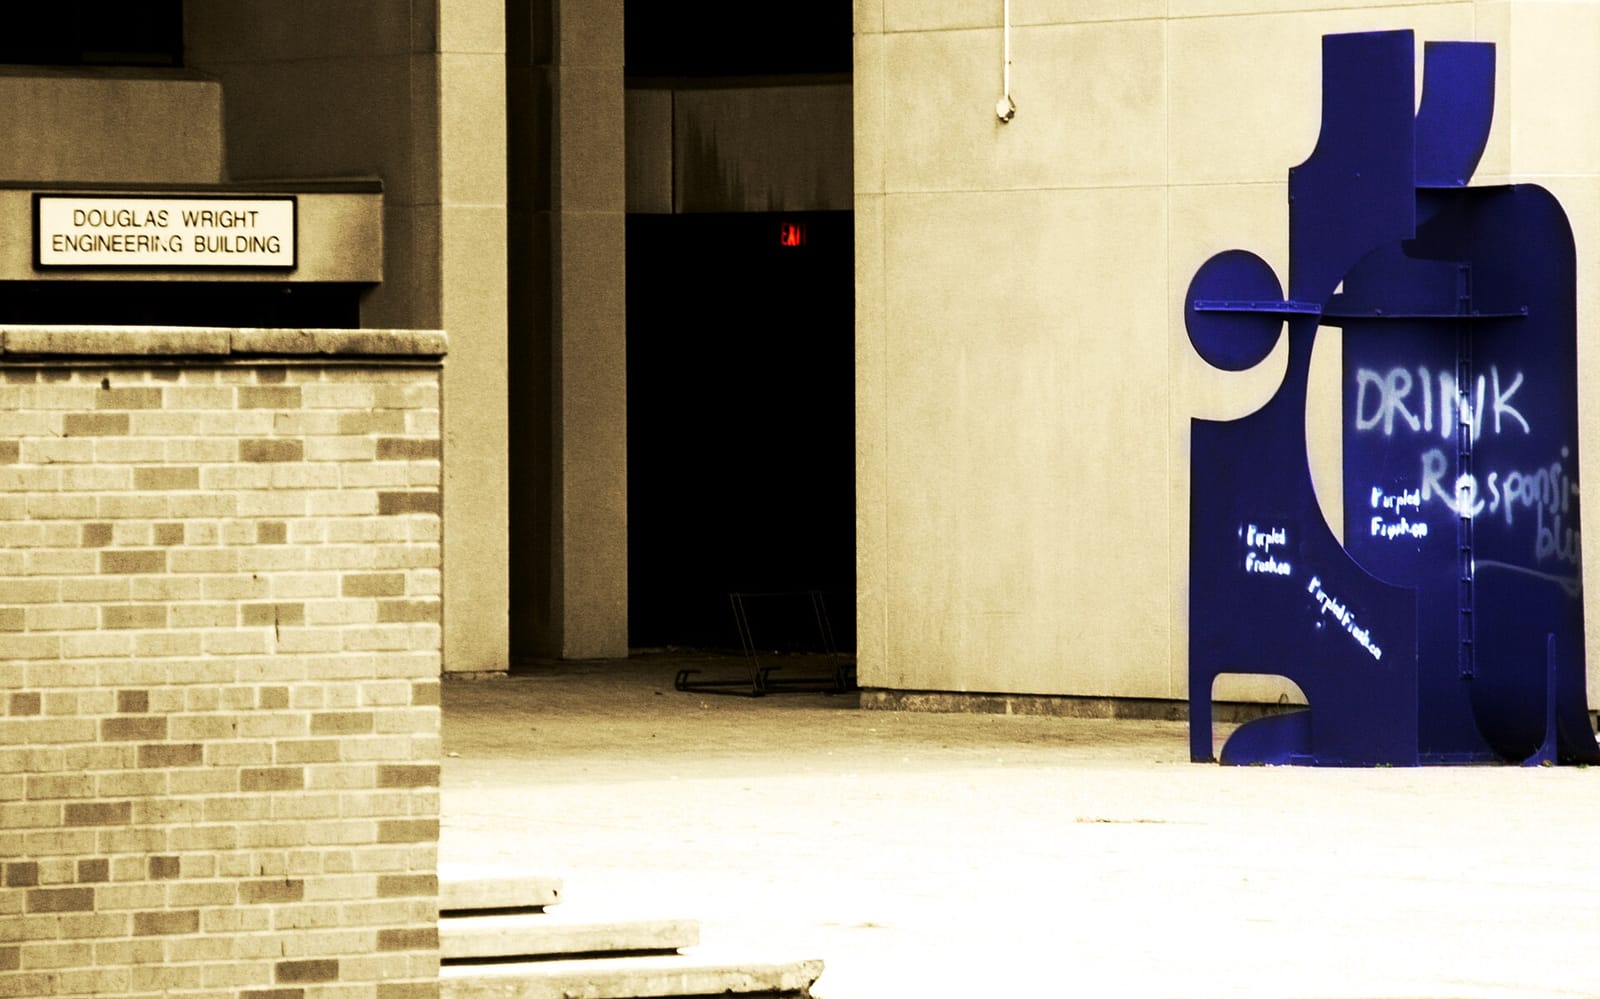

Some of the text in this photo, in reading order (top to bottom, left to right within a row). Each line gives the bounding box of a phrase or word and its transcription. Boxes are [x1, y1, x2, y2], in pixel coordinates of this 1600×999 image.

[73, 209, 258, 228] DOUGLAS WRIGHT
[194, 236, 280, 253] BUILDING
[1356, 366, 1530, 440] DRINK
